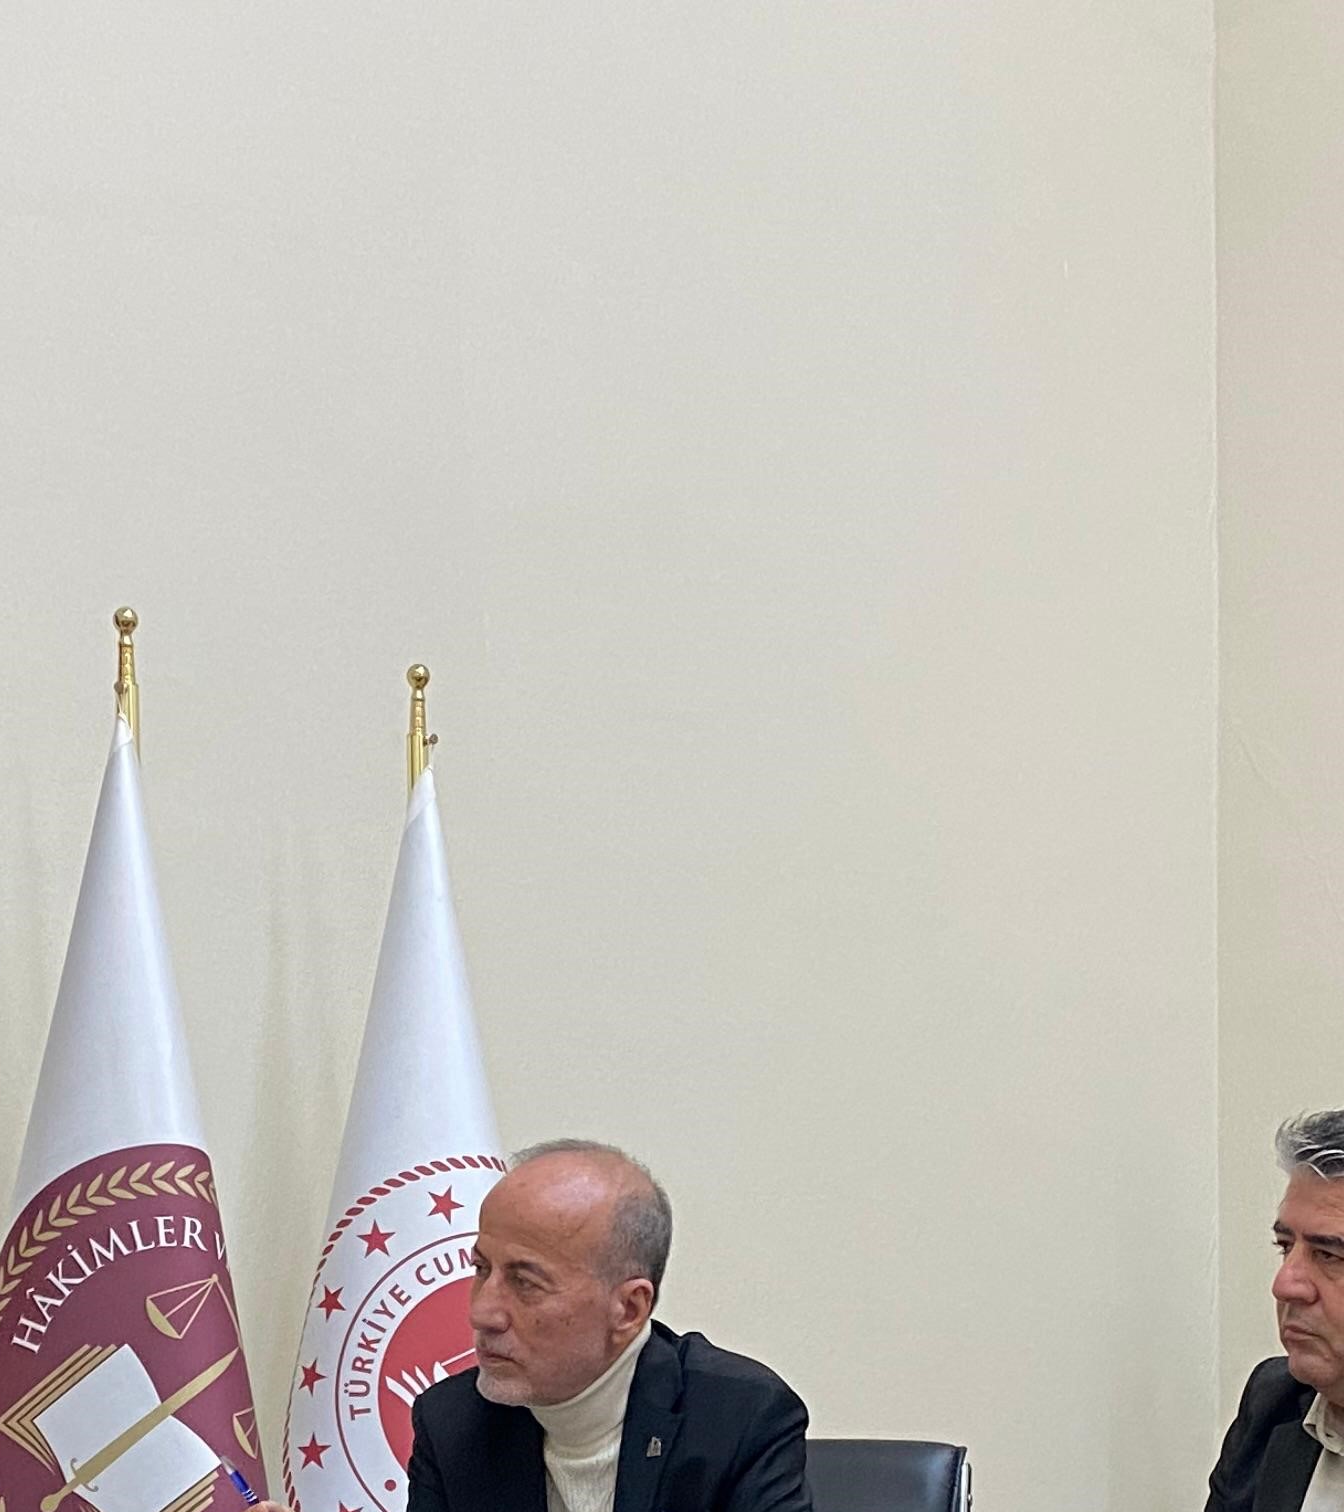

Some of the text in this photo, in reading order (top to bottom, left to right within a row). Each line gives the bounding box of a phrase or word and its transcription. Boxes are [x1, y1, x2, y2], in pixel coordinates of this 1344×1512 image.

[10, 1215, 208, 1354] HÂKİMLER
[343, 1247, 474, 1421] TÜRKİYE CUM
